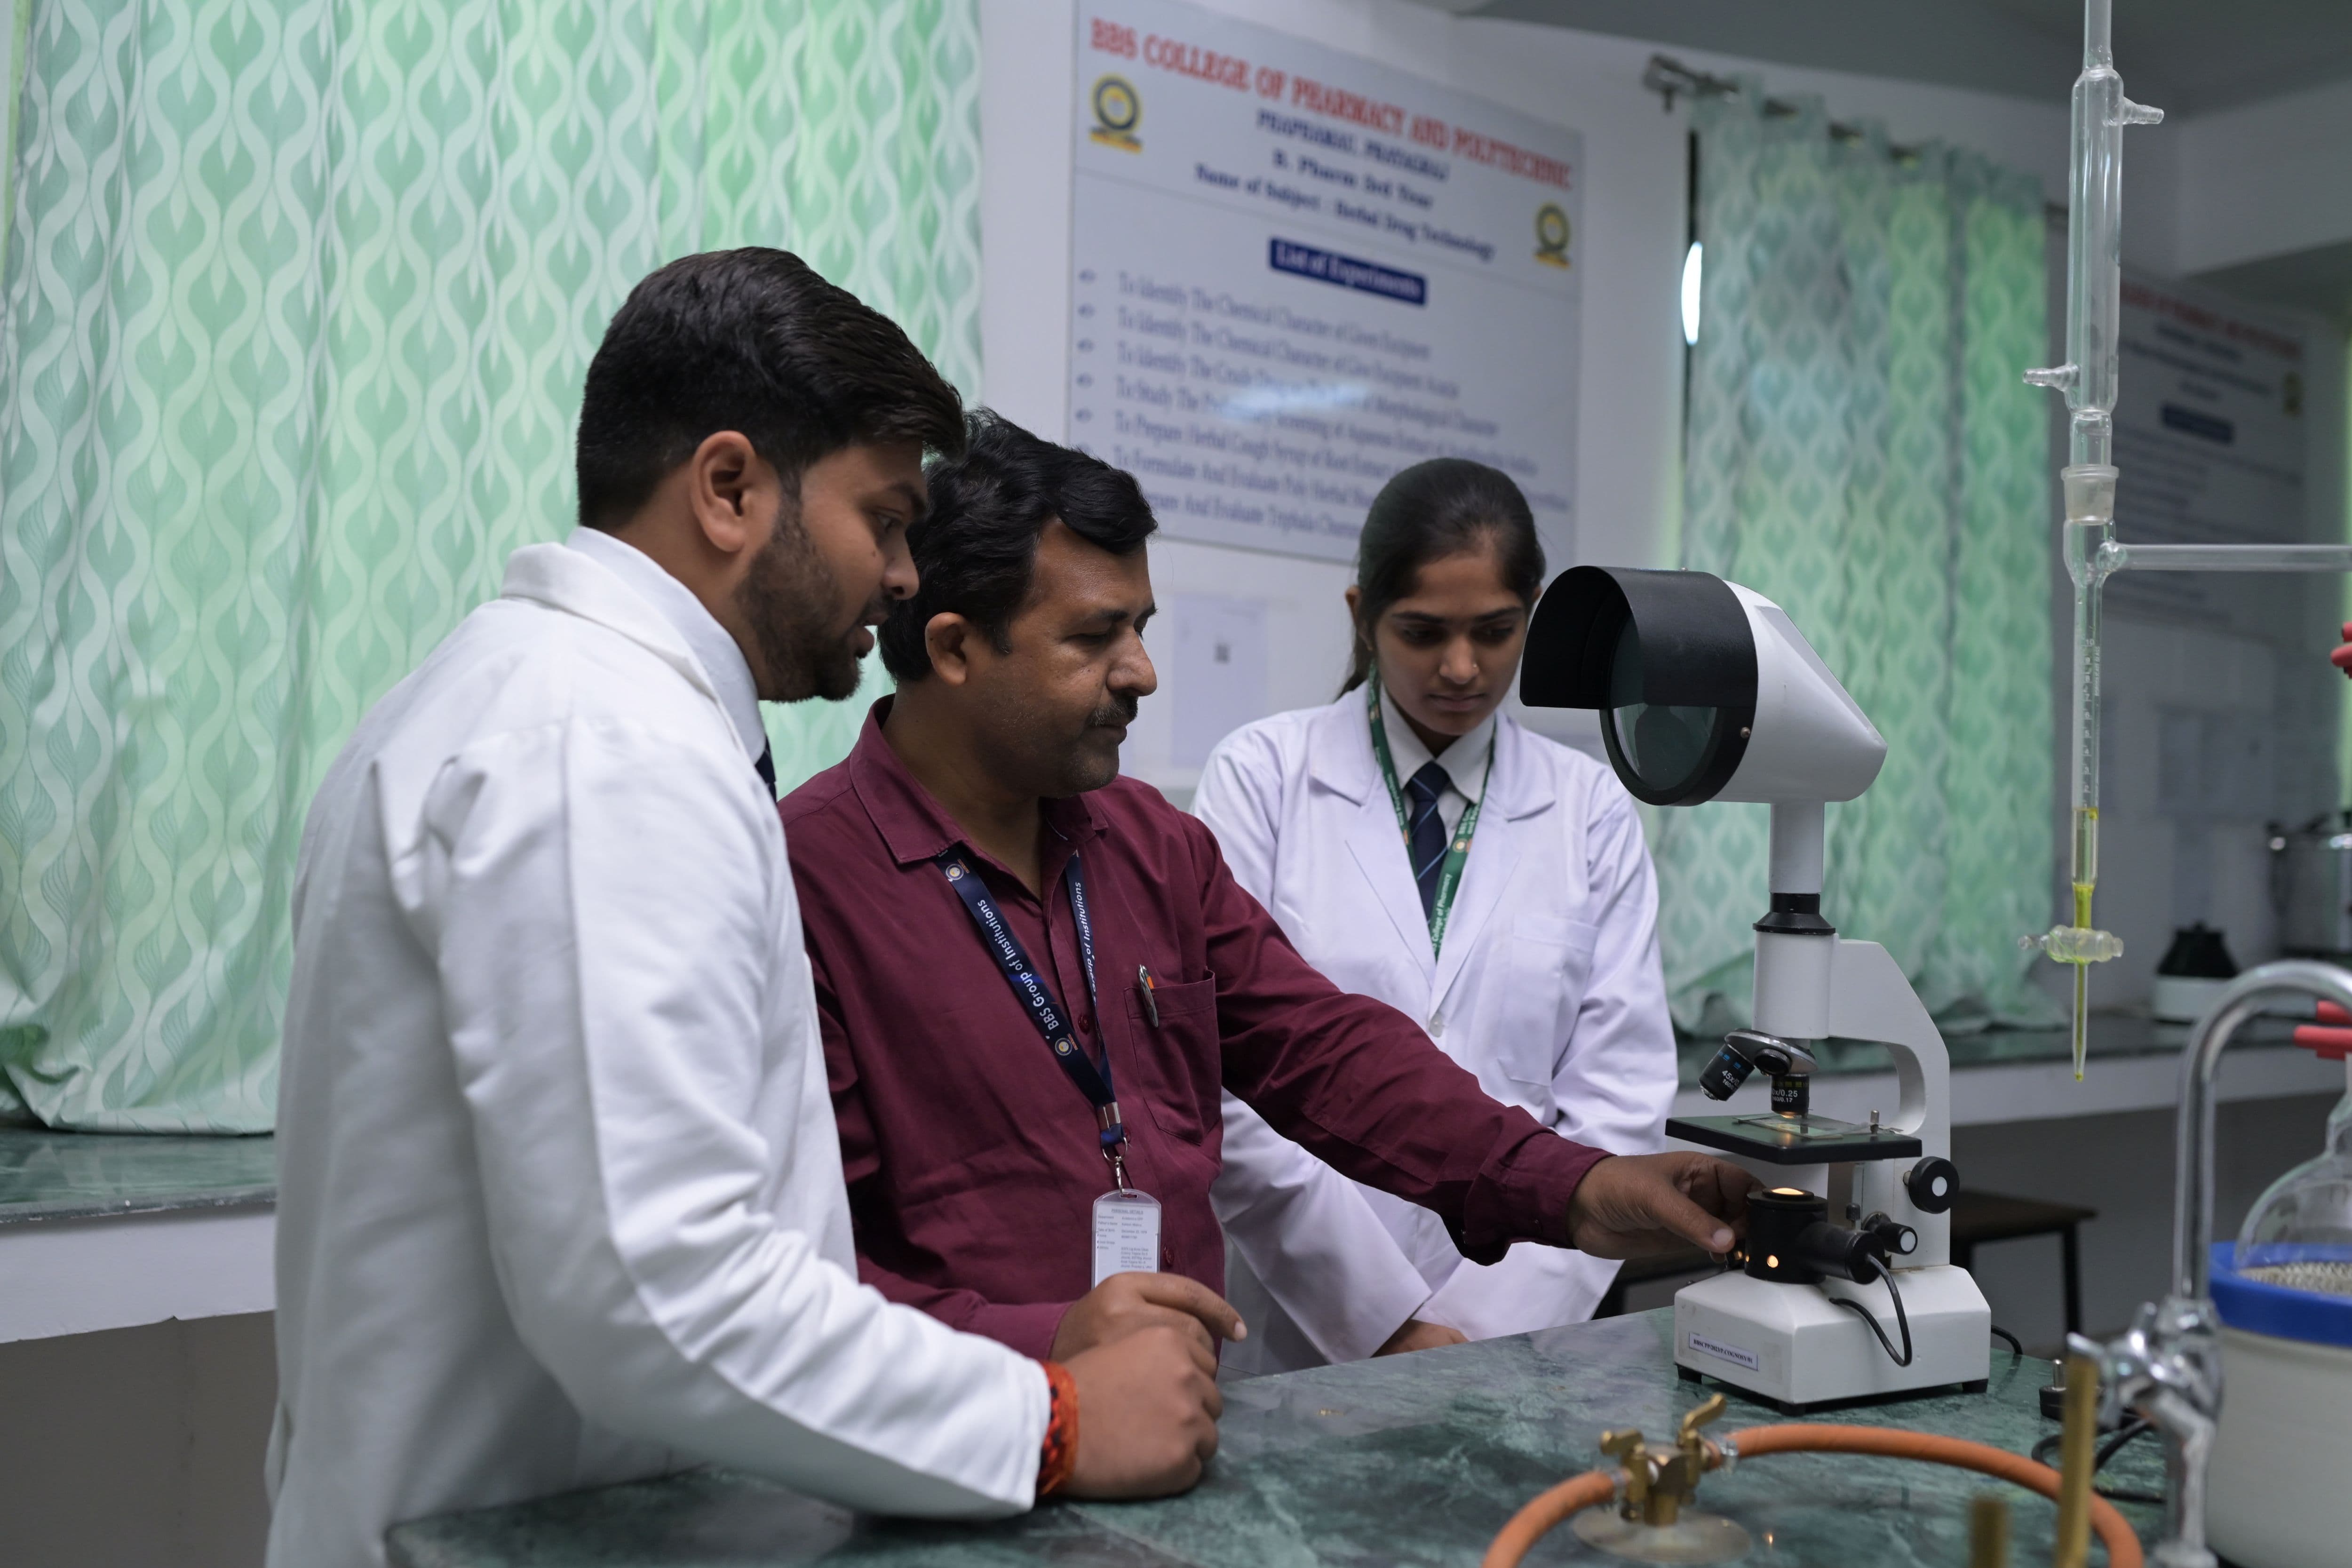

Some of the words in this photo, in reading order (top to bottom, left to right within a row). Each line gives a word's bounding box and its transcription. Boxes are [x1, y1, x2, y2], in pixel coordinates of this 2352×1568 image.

[1090, 17, 1138, 60] BBS
[1143, 33, 1251, 93] COLLEGE
[1255, 65, 1287, 100] OF
[1291, 75, 1406, 137] PHARMACY
[1409, 115, 1449, 150] AND
[1452, 126, 1573, 191] POLYTECHNIC
[1273, 148, 1293, 168] B.
[1297, 153, 1358, 186] Pharm
[1195, 162, 1240, 190] Name
[1244, 176, 1263, 194] of
[1265, 180, 1321, 210] Subject
[1335, 198, 1379, 228] Herbal
[1385, 214, 1416, 243] Drug
[1420, 222, 1497, 263] Technology
[1275, 242, 1308, 269] List
[1310, 254, 1328, 279] of
[1328, 256, 1421, 298] Experiments
[1118, 271, 1134, 294] To
[1191, 287, 1214, 311] The
[1116, 305, 1133, 329] To
[1191, 320, 1213, 344] The
[1115, 339, 1132, 364] To
[1190, 354, 1212, 379] The
[1177, 386, 1200, 410] The
[1437, 873, 1453, 907] Pharmacy
[1075, 882, 1090, 940] Institutions
[1436, 907, 1444, 916] of
[977, 899, 1016, 960] Institutions
[1009, 959, 1023, 971] of
[1084, 942, 1091, 955] of
[1020, 972, 1045, 1007] Group
[1087, 958, 1096, 992] Group
[1040, 1008, 1059, 1030] BBS
[1772, 1088, 1798, 1098] 0x/0.25
